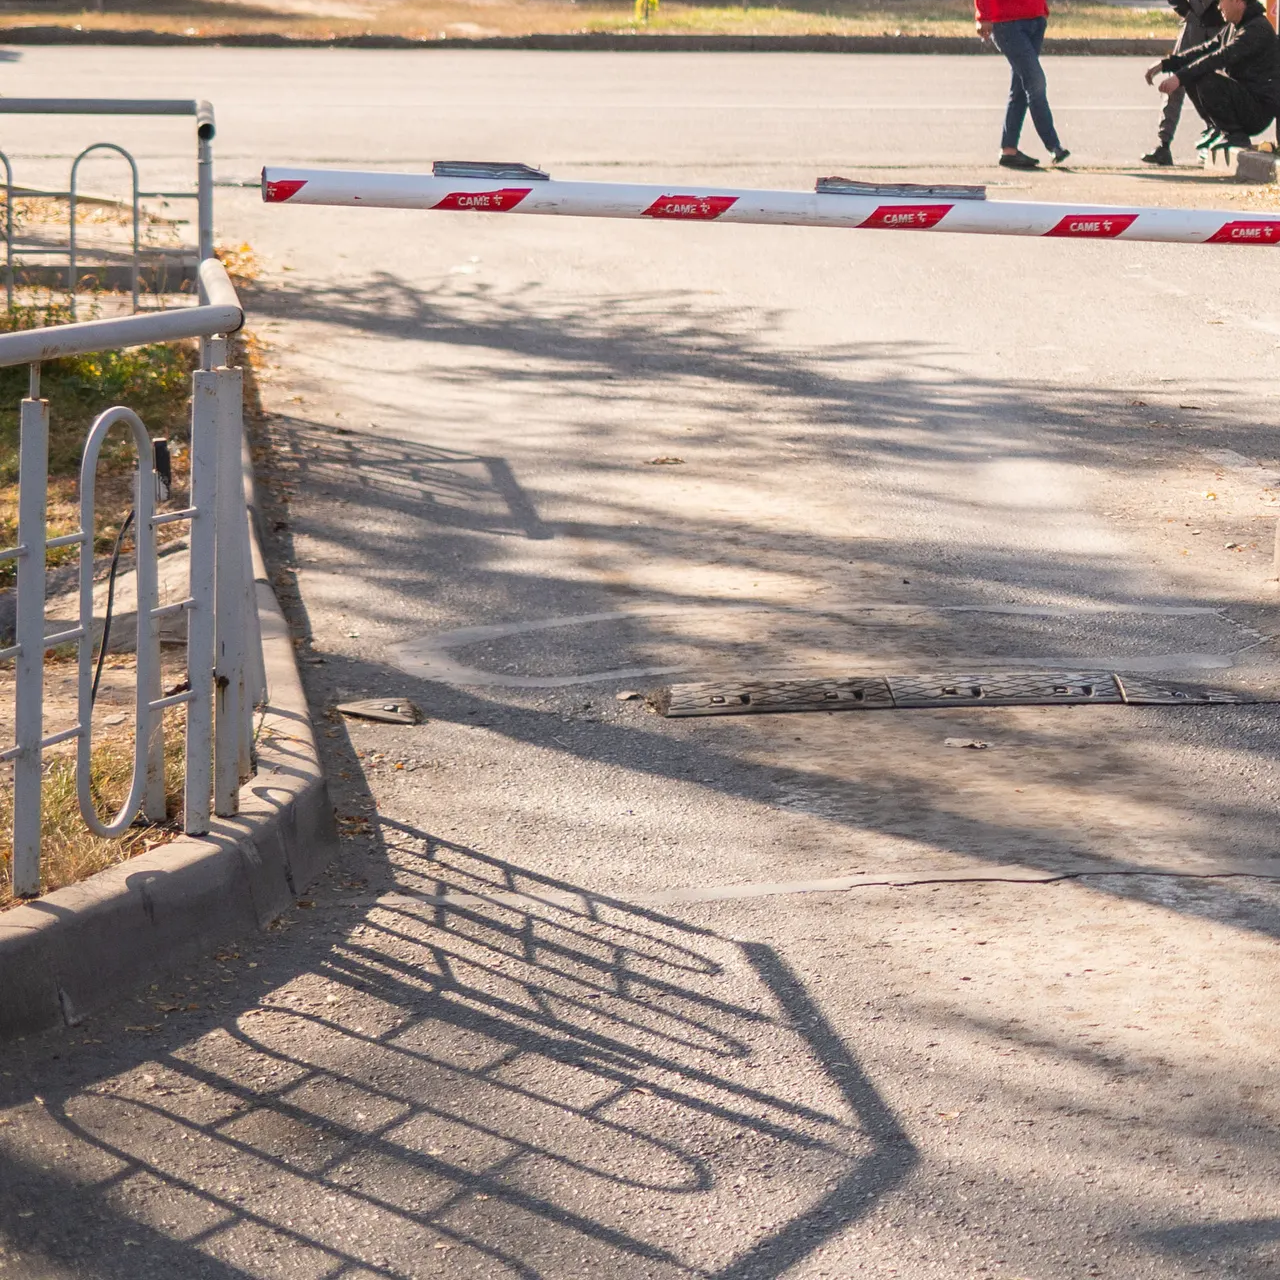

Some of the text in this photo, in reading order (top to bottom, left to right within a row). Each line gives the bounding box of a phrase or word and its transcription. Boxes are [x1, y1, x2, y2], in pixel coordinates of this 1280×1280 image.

[458, 196, 490, 206] CAME
[666, 203, 697, 214] CAME
[883, 214, 914, 224] CAME
[1070, 222, 1101, 232] CAME
[1231, 228, 1261, 238] CAME
